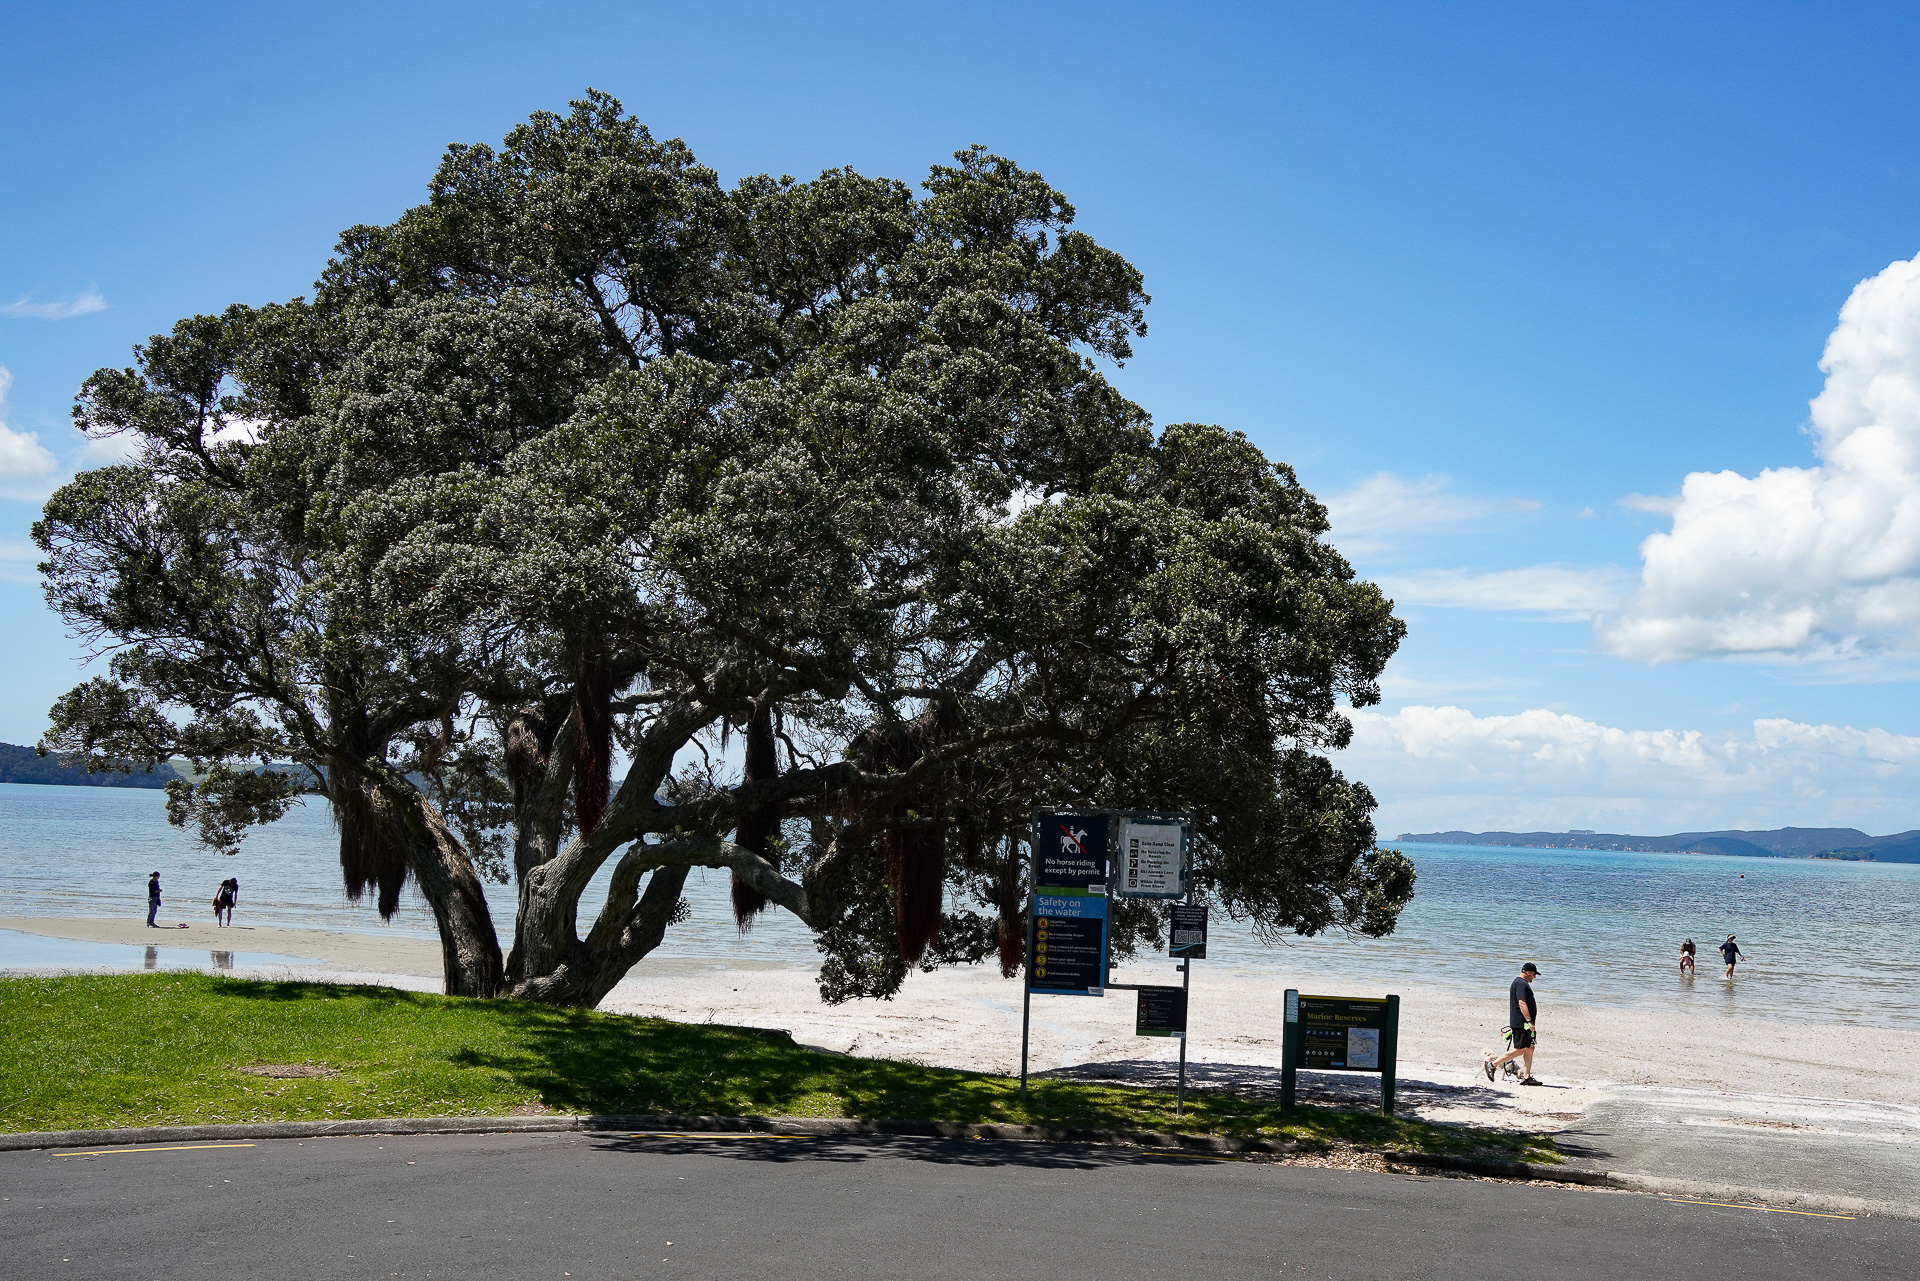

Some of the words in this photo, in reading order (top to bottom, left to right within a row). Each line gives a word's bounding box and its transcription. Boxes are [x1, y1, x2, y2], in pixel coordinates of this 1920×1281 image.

[1077, 859, 1096, 868] riding
[1039, 897, 1067, 908] Safety
[1038, 907, 1053, 915] the
[1055, 908, 1081, 916] water
